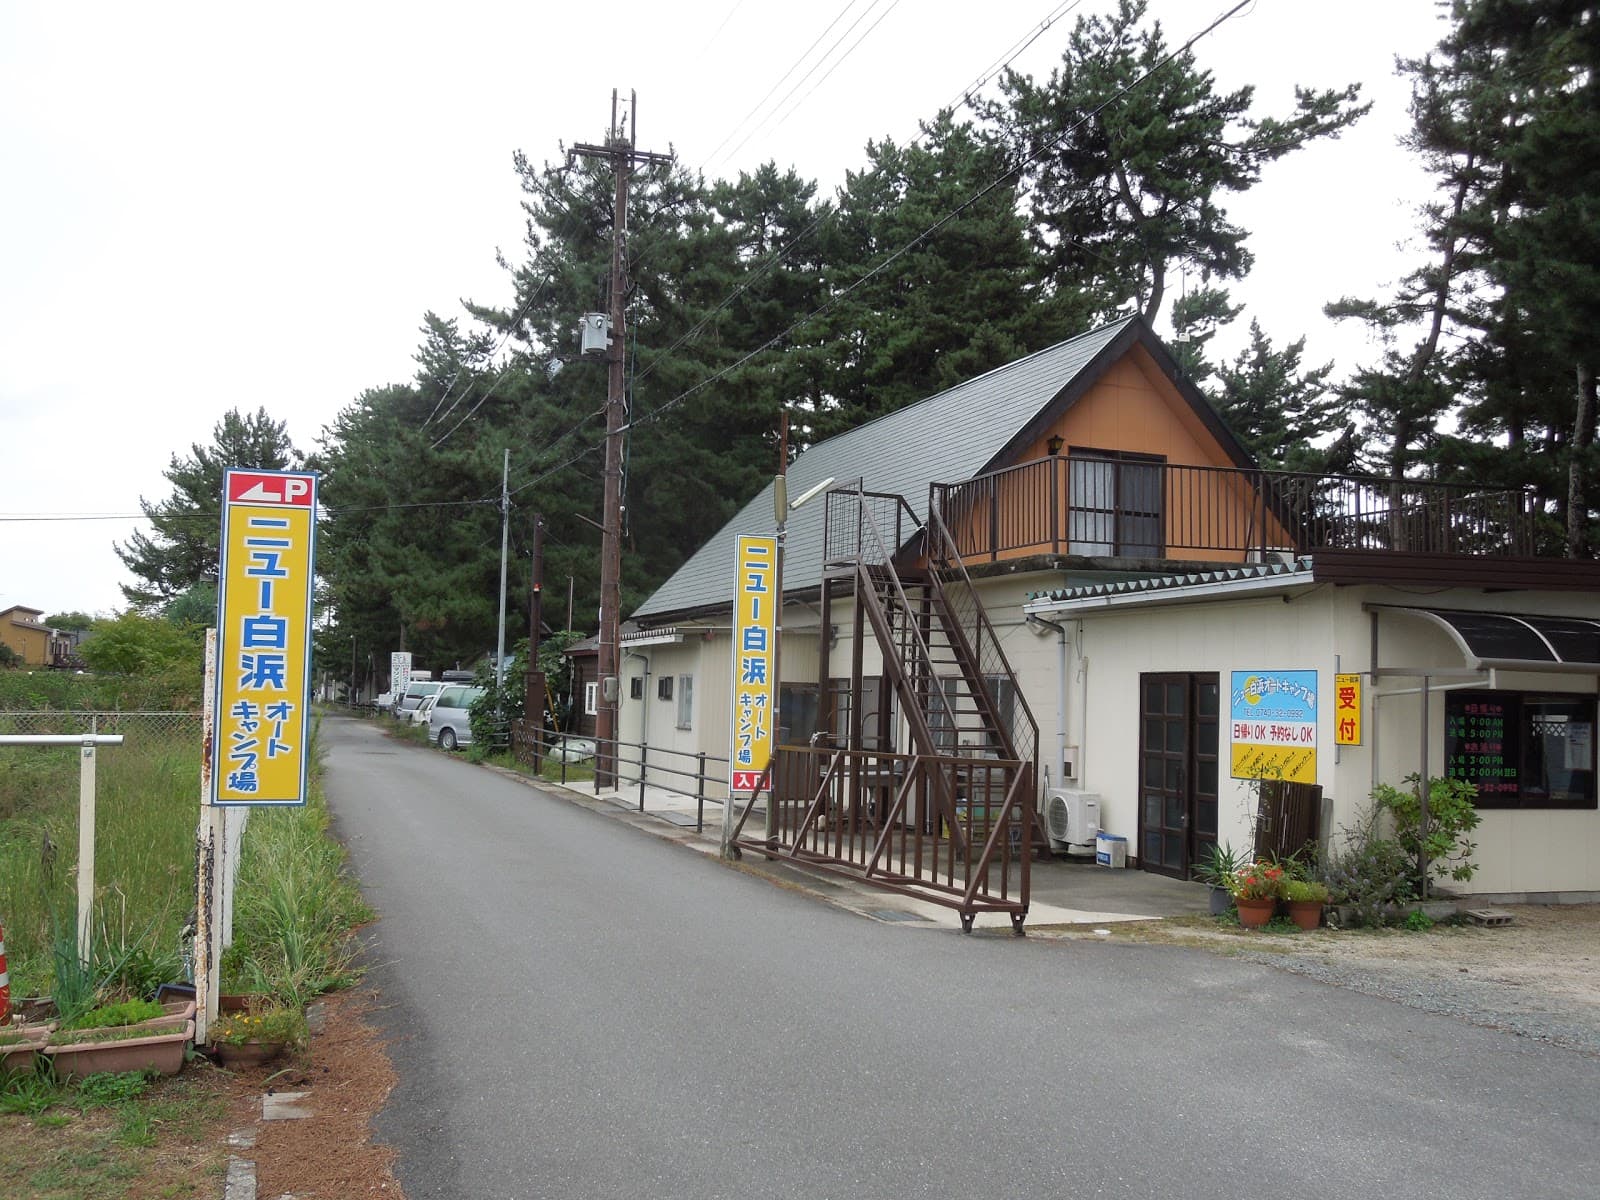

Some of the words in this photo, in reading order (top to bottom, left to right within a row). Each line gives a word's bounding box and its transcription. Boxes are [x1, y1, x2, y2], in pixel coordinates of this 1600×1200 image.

[284, 479, 308, 503] P
[240, 517, 290, 690] ニュー白浜
[742, 547, 768, 684] ニュー白浜
[264, 701, 294, 758] オート
[738, 692, 752, 765] キャンプ場
[753, 693, 768, 740] オート
[1339, 686, 1356, 741] 受付
[228, 701, 259, 792] キャンプ場
